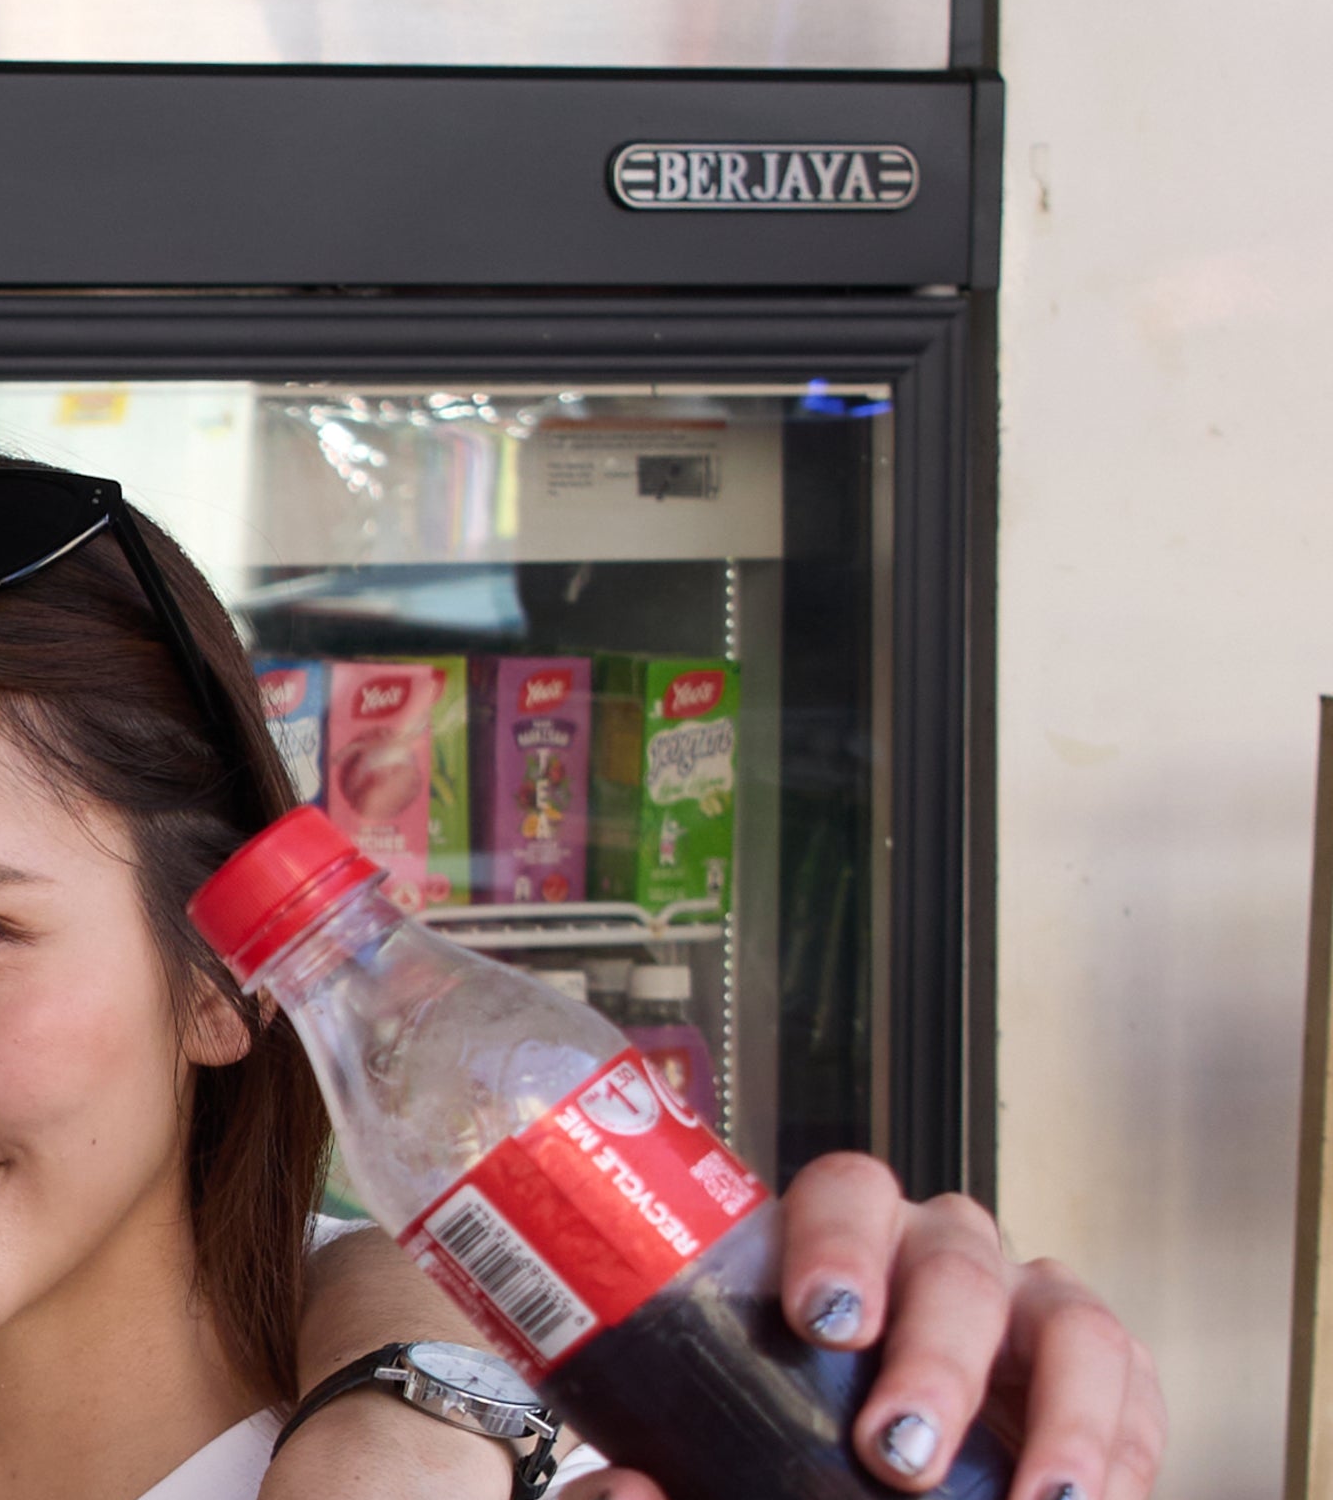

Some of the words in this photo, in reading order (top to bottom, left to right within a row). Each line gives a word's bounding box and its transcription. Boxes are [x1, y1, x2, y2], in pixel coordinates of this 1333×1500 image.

[656, 152, 876, 200] BERJAYA
[554, 1104, 603, 1153] ME
[592, 1145, 701, 1258] RECYCLE
